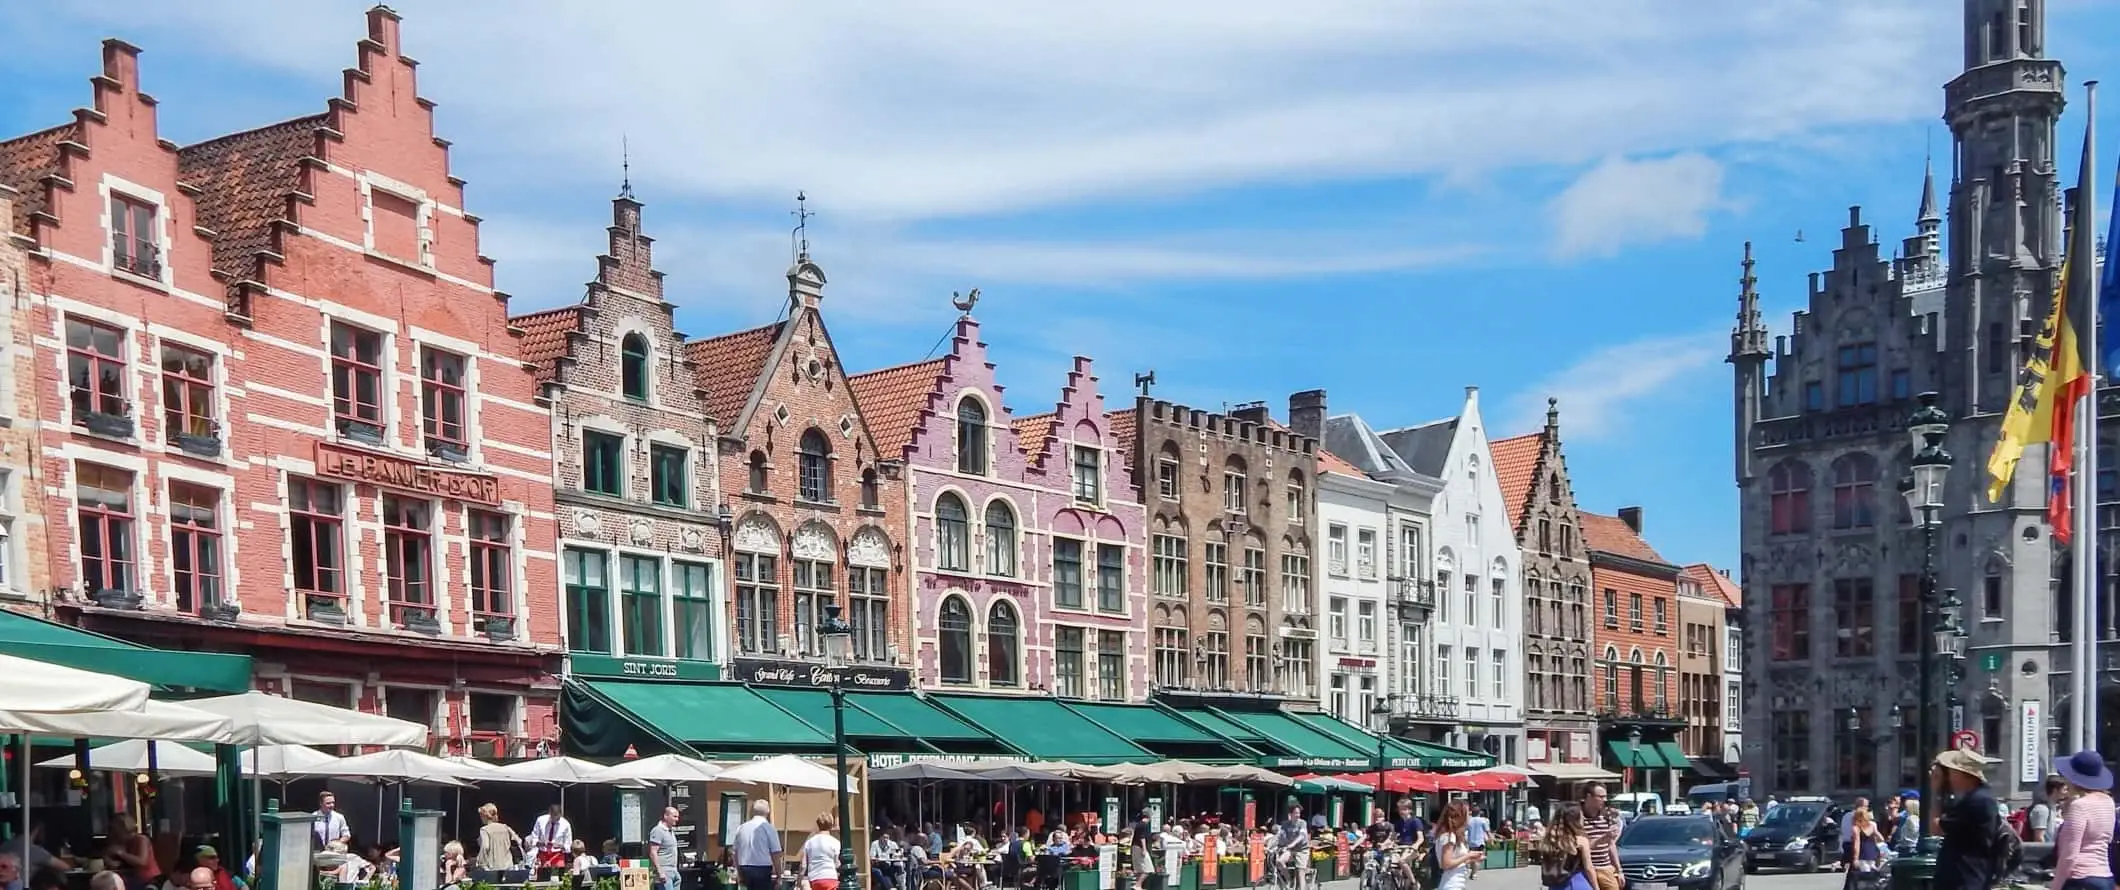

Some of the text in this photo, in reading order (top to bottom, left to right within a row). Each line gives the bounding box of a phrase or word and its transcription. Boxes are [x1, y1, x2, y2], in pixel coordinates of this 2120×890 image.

[361, 455, 441, 493] PANIER
[448, 475, 494, 502] D'OR
[624, 662, 677, 676] SINT JORIS
[754, 667, 779, 682] Grand
[2027, 716, 2035, 775] HISTORIUM
[871, 754, 902, 768] HOTEL
